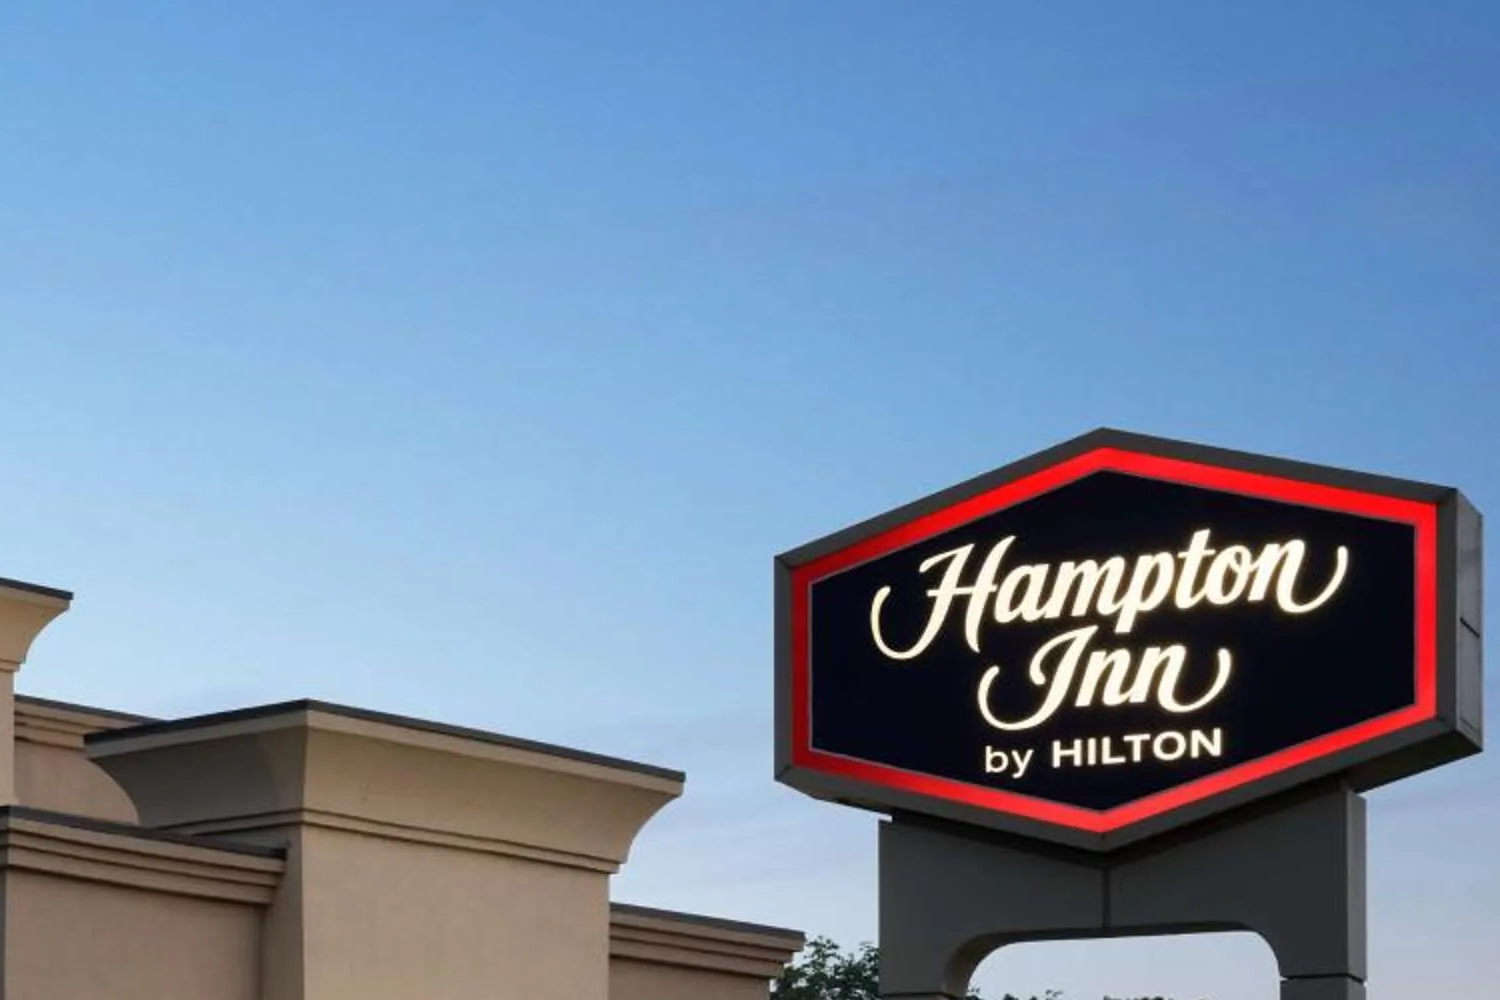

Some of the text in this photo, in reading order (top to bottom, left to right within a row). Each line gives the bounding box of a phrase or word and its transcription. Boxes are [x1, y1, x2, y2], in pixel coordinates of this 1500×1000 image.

[870, 527, 1349, 660] Hampton
[977, 624, 1233, 731] Inn
[984, 727, 1223, 779] by HILTON
